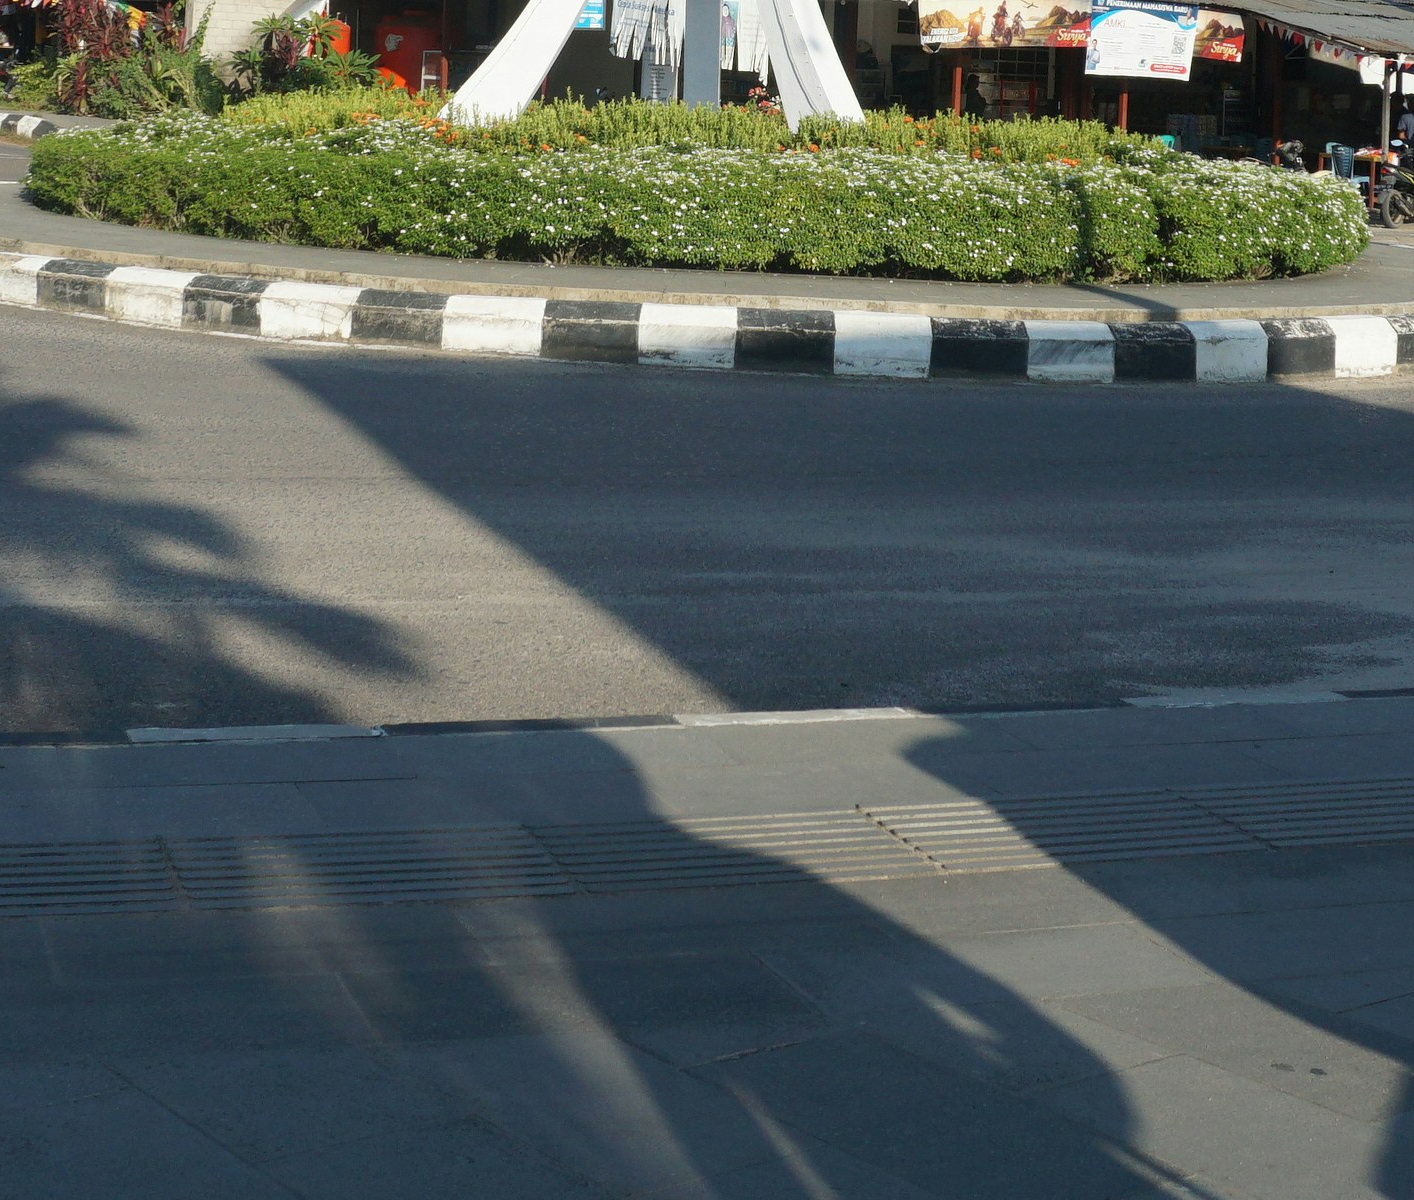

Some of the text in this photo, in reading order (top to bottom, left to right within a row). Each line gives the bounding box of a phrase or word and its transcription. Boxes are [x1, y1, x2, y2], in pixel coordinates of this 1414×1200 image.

[1106, 0, 1142, 9] PENERIMAAN
[1142, 2, 1173, 12] MAHASISWA
[1057, 28, 1089, 47] Surya
[1211, 41, 1239, 60] Surya
